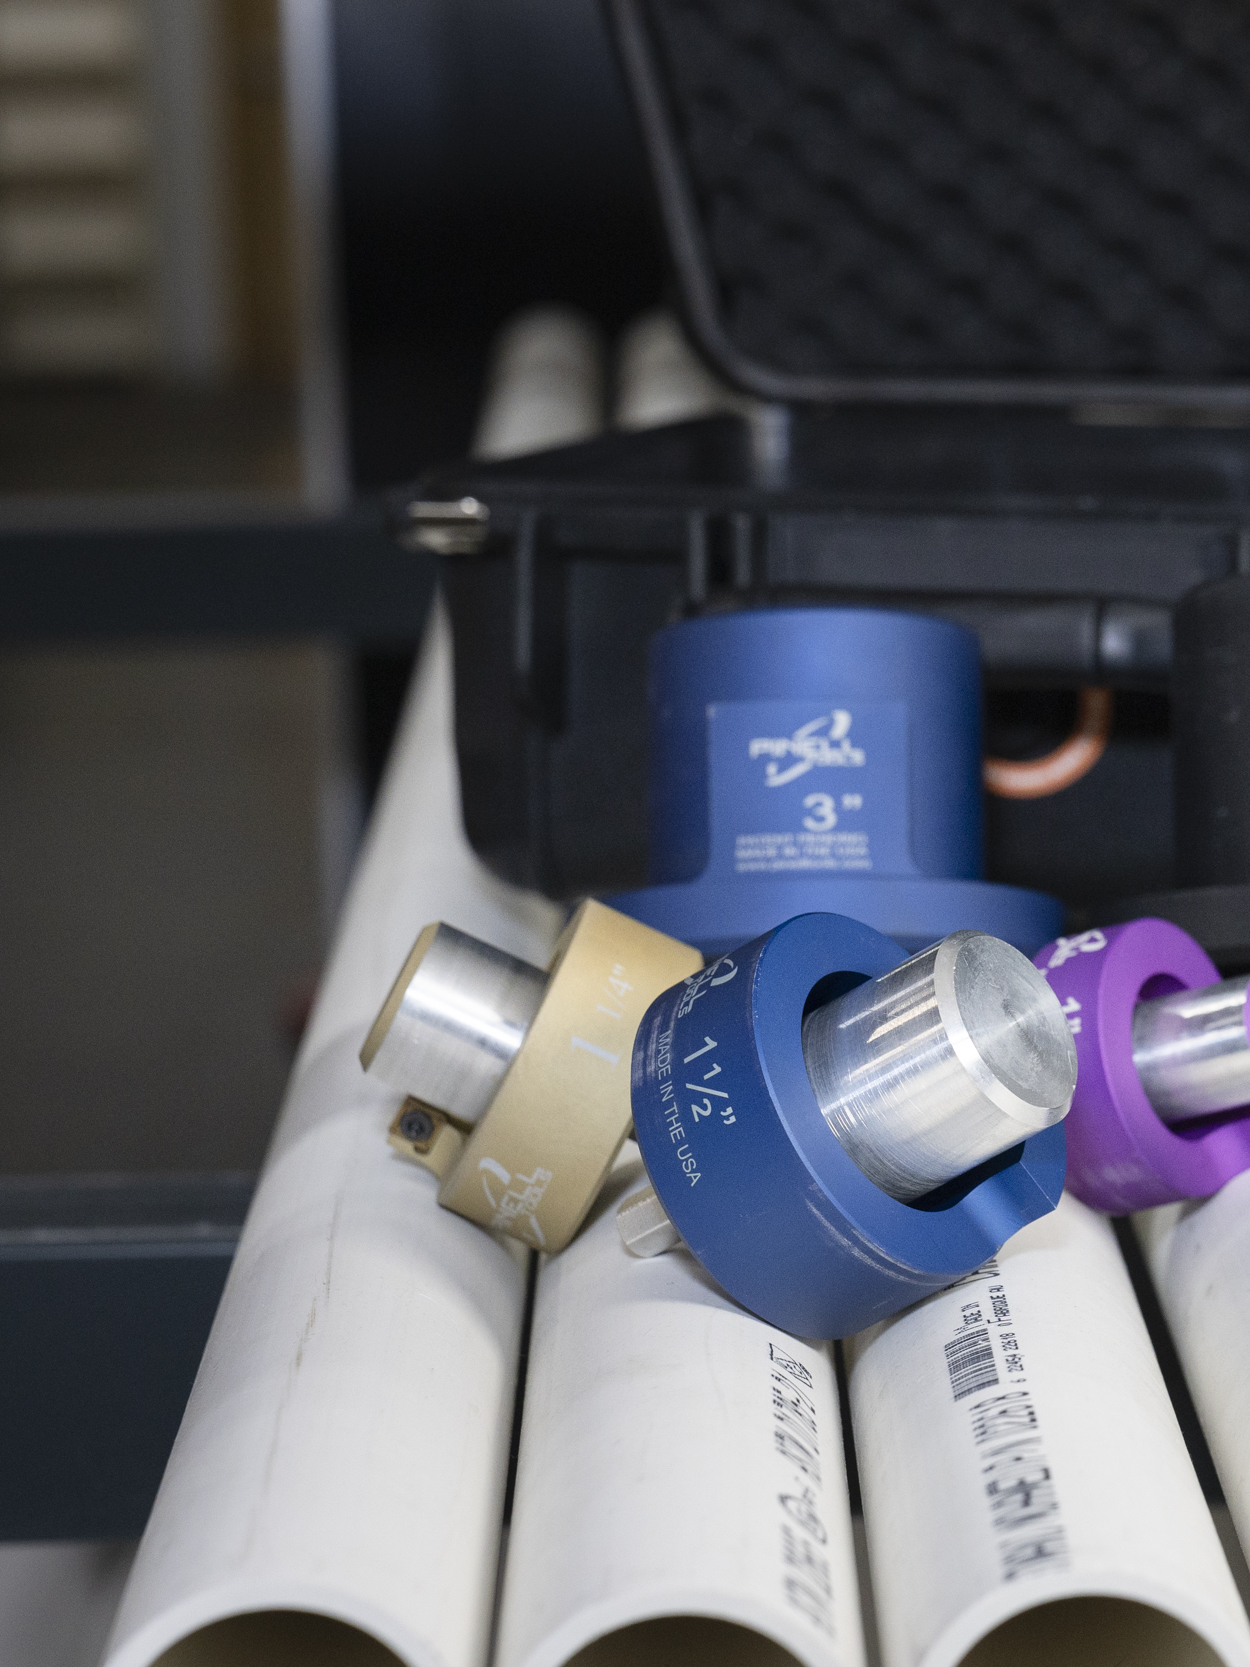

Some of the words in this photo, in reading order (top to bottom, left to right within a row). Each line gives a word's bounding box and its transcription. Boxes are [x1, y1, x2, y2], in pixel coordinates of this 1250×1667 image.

[657, 1030, 672, 1080] MADE
[660, 1081, 675, 1102] IN
[664, 1103, 685, 1143] THE
[677, 1145, 701, 1187] USA
